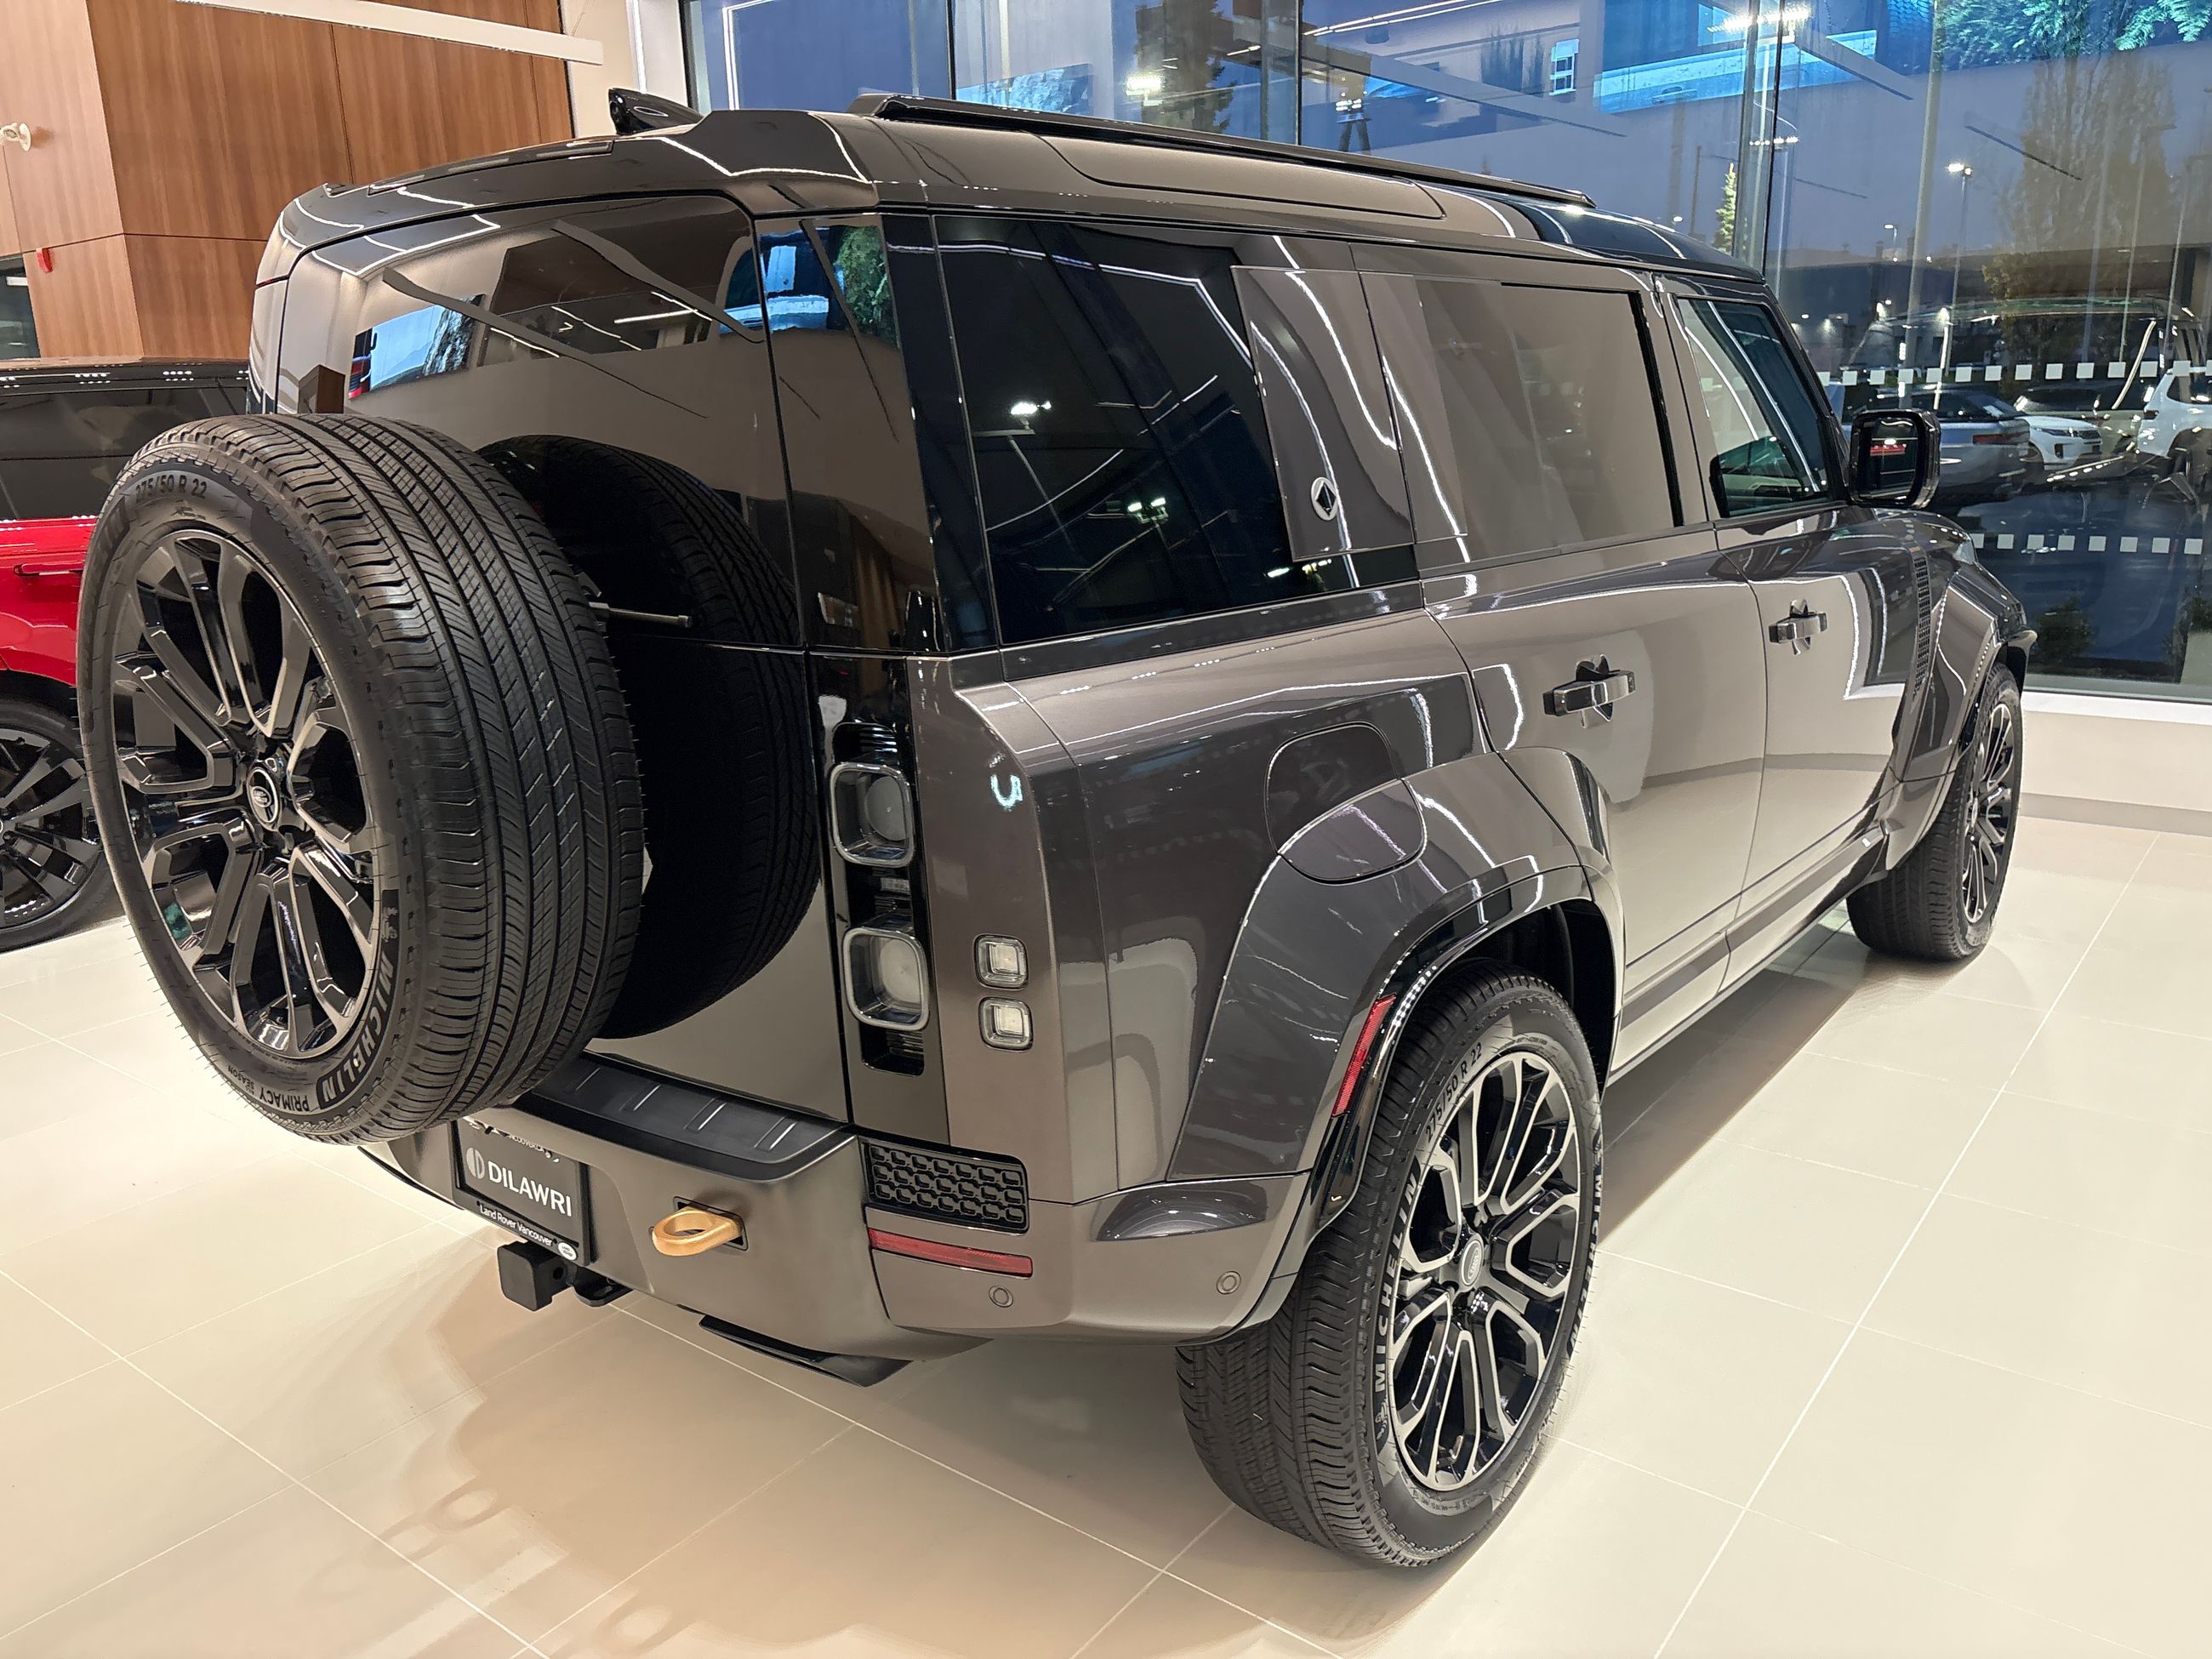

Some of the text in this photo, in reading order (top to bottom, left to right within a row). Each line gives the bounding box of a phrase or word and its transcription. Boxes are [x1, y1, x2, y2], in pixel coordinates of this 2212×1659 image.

[179, 475, 187, 493] R
[191, 478, 208, 499] 22
[322, 950, 394, 1103] MICHELIN
[228, 1065, 255, 1090] SEASON
[259, 1086, 311, 1112] PRIMACY
[1425, 1042, 1482, 1143] 275/50 R 22
[487, 1160, 572, 1217] DILAWRI
[480, 1204, 554, 1246] Land Rover Vancouver
[1375, 1173, 1418, 1394] MICHELIN
